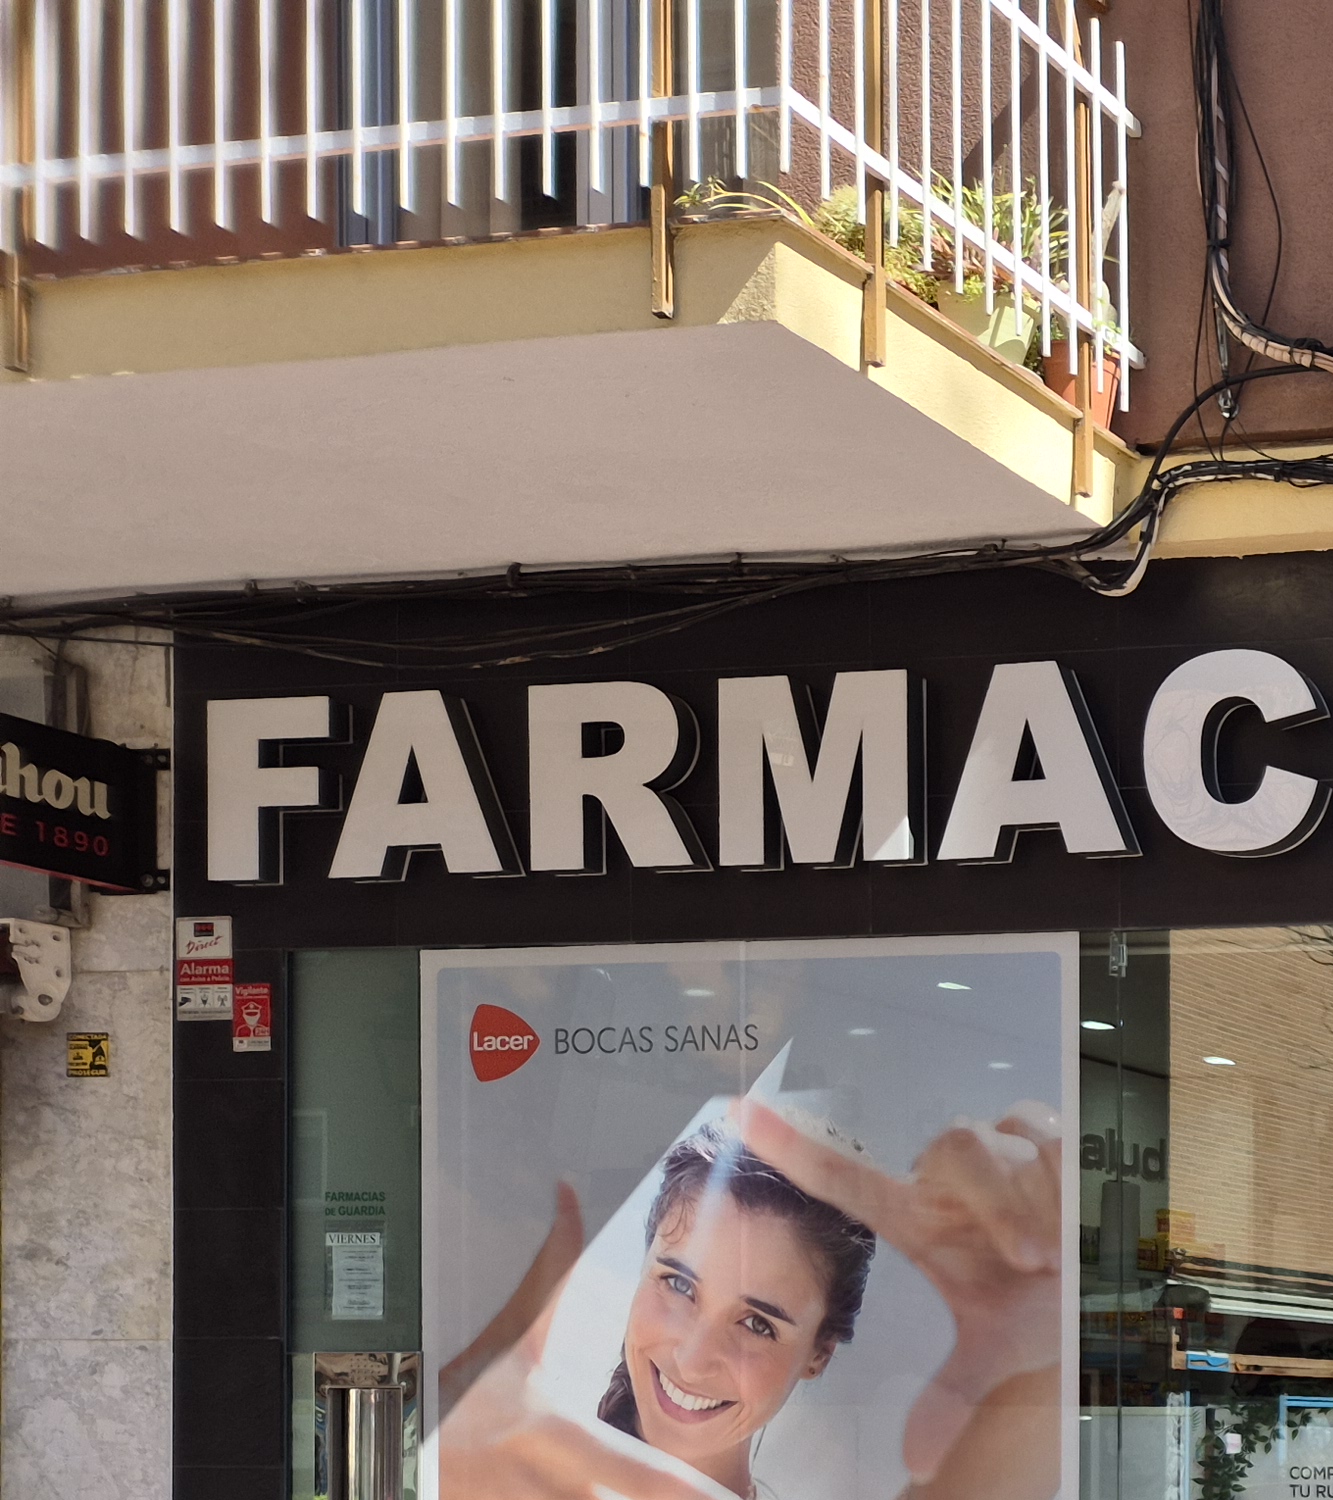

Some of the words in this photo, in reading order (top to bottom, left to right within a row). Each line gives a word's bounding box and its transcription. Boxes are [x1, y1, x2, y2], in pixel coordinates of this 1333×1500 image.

[35, 820, 110, 857] 1890
[180, 963, 230, 976] Alarma
[472, 1031, 534, 1052] Lacer
[554, 1026, 654, 1054] BOCAS
[664, 1023, 760, 1052] SANAS
[324, 1191, 386, 1203] FARMACIAS
[338, 1205, 386, 1216] GUARDIA
[328, 1234, 377, 1244] VIERNES
[1289, 1484, 1311, 1499] TU
